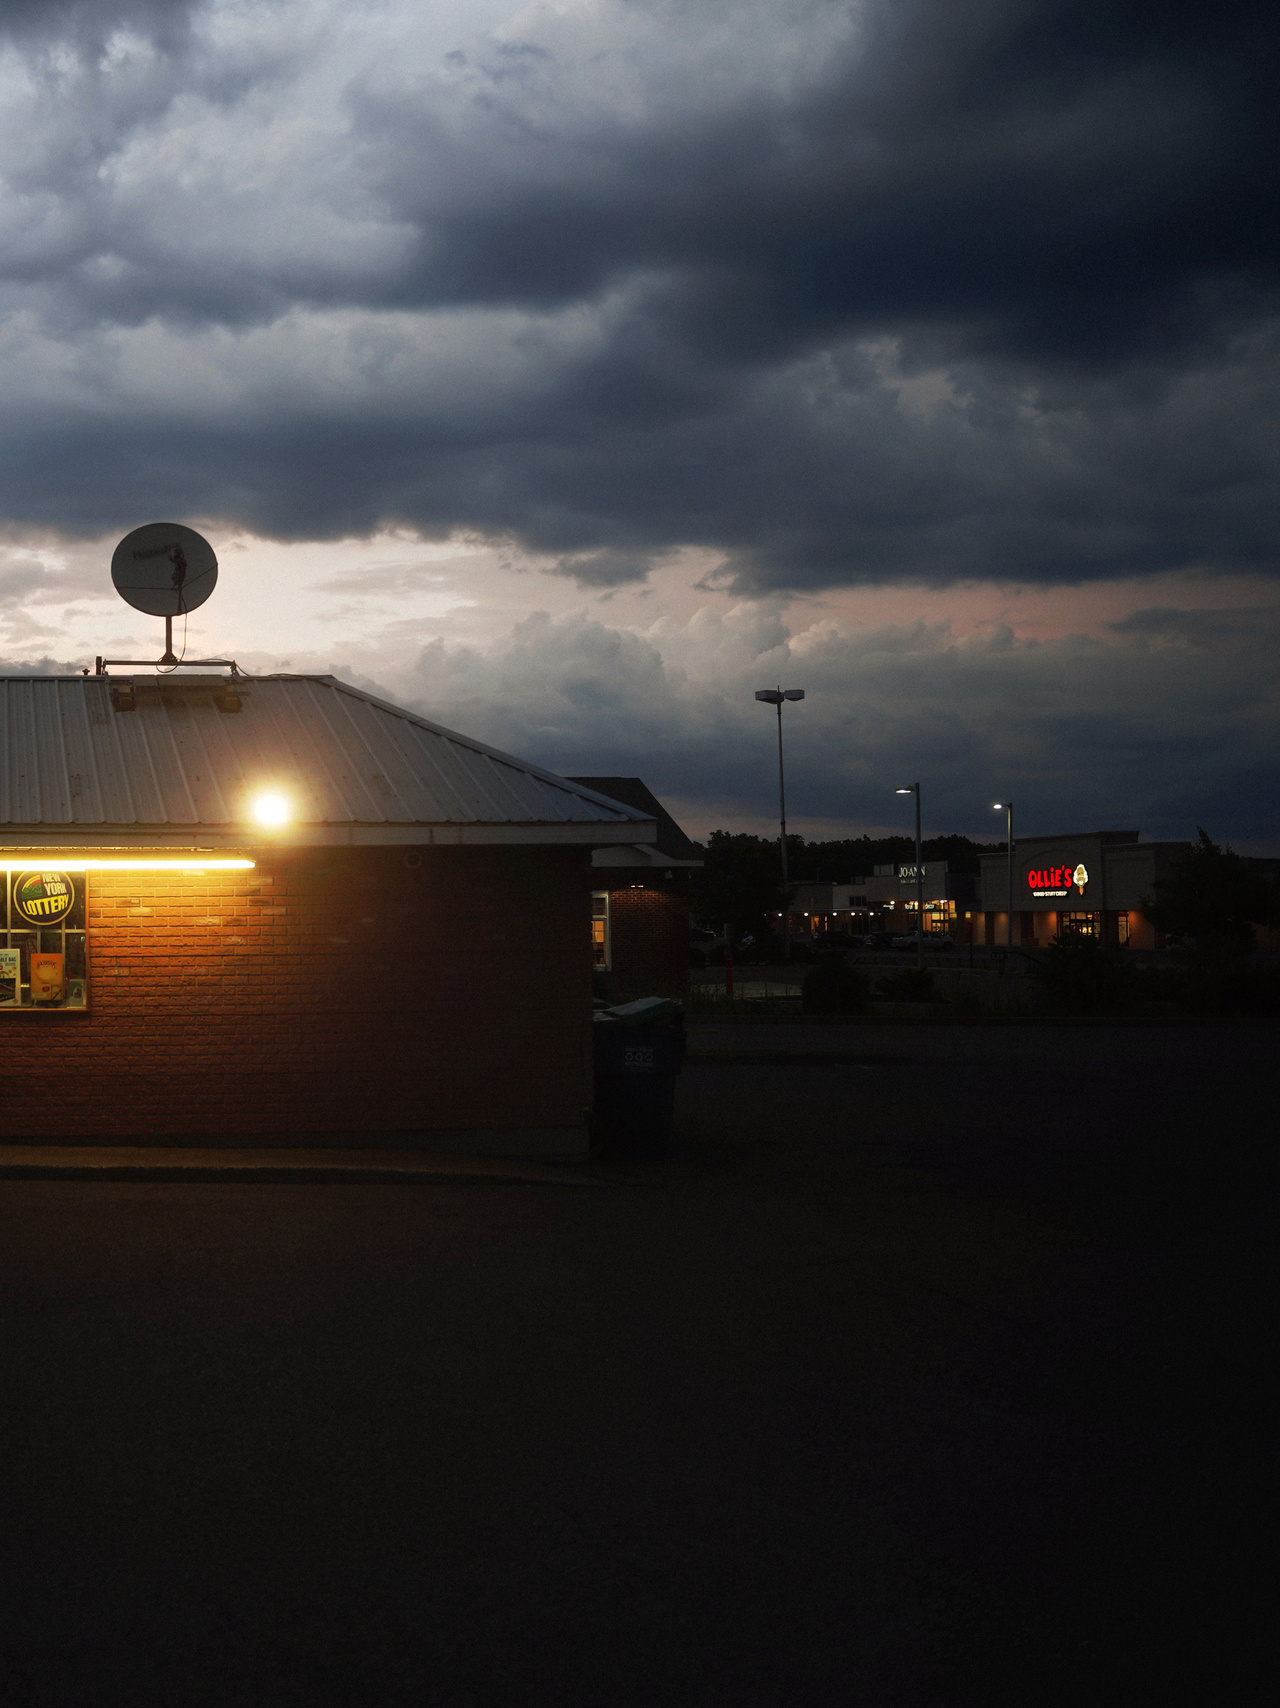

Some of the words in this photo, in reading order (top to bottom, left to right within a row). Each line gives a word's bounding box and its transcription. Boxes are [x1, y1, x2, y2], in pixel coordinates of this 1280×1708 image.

[42, 873, 61, 883] NEW
[44, 883, 67, 896] YORK
[22, 894, 69, 915] LOTTERY
